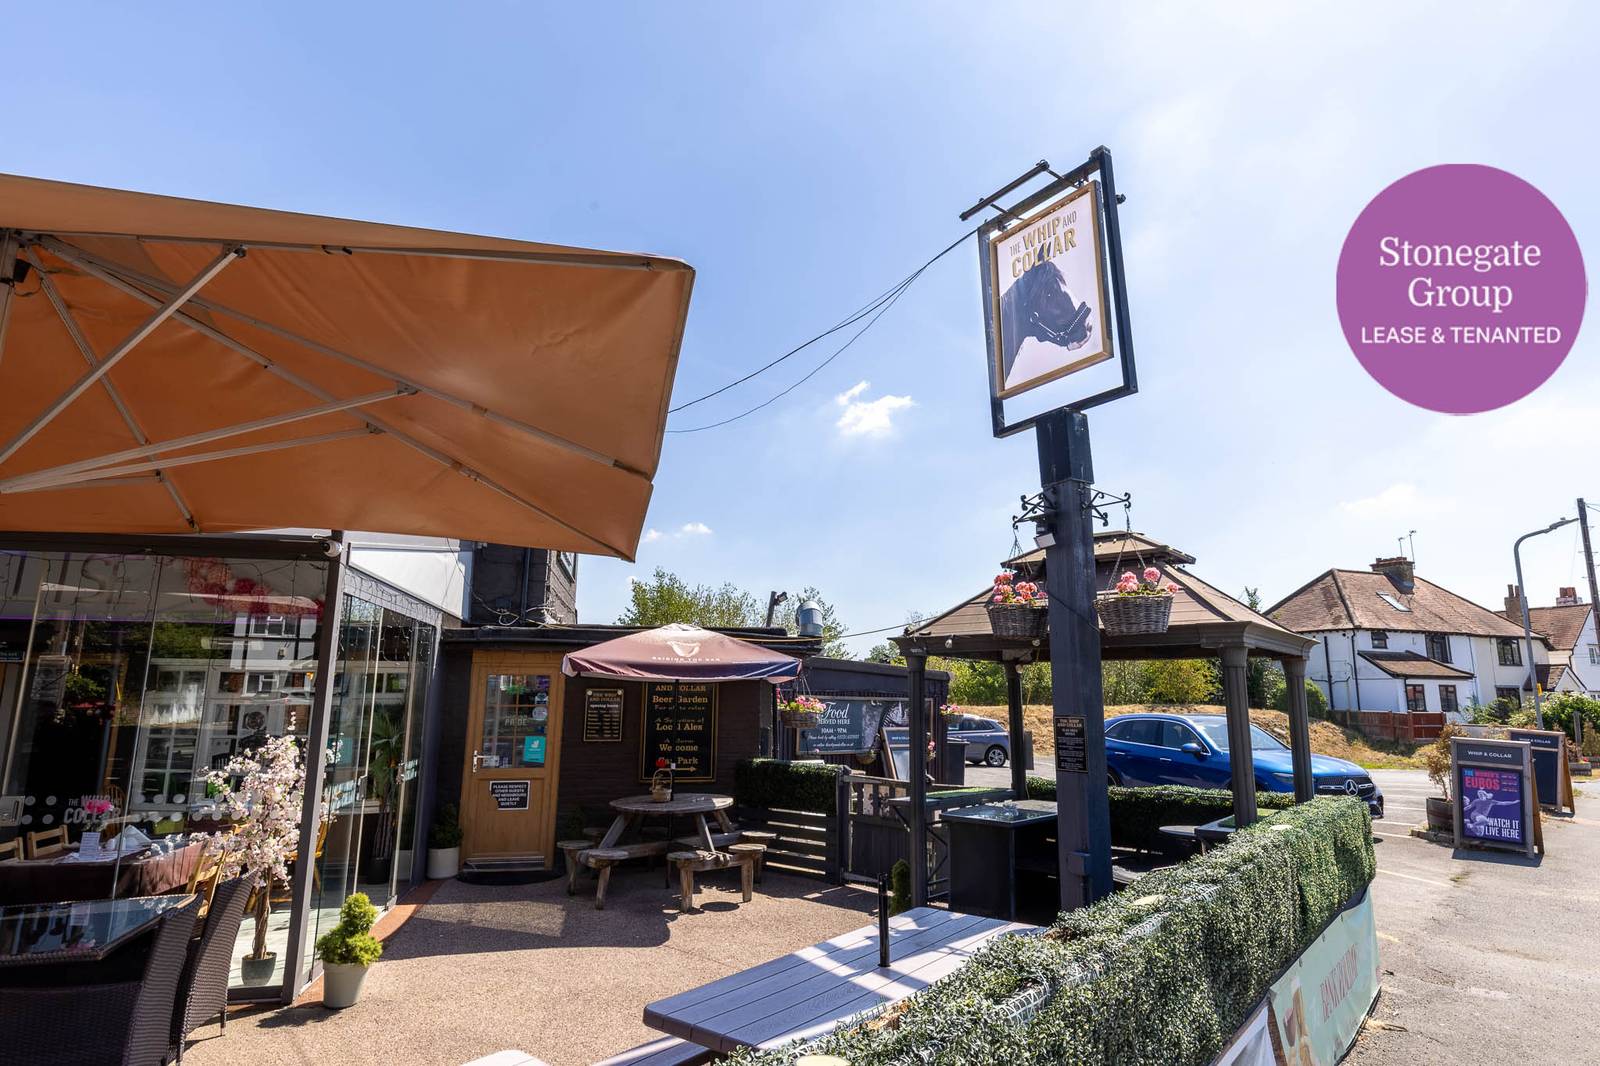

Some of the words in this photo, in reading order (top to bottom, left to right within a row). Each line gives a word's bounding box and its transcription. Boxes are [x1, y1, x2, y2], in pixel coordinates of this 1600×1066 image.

[1010, 241, 1021, 257] THE
[1023, 217, 1061, 250] WHIP
[1062, 210, 1078, 229] AND
[1012, 227, 1077, 278] COLLAR
[820, 701, 850, 720] Food
[656, 723, 681, 731] Locl
[683, 723, 703, 731] Ales
[1465, 777, 1500, 790] EUROS
[68, 798, 80, 807] THE
[1488, 817, 1510, 828] WATCH
[1512, 820, 1520, 830] IT
[1485, 826, 1500, 837] LIVE
[1501, 828, 1520, 839] HERE
